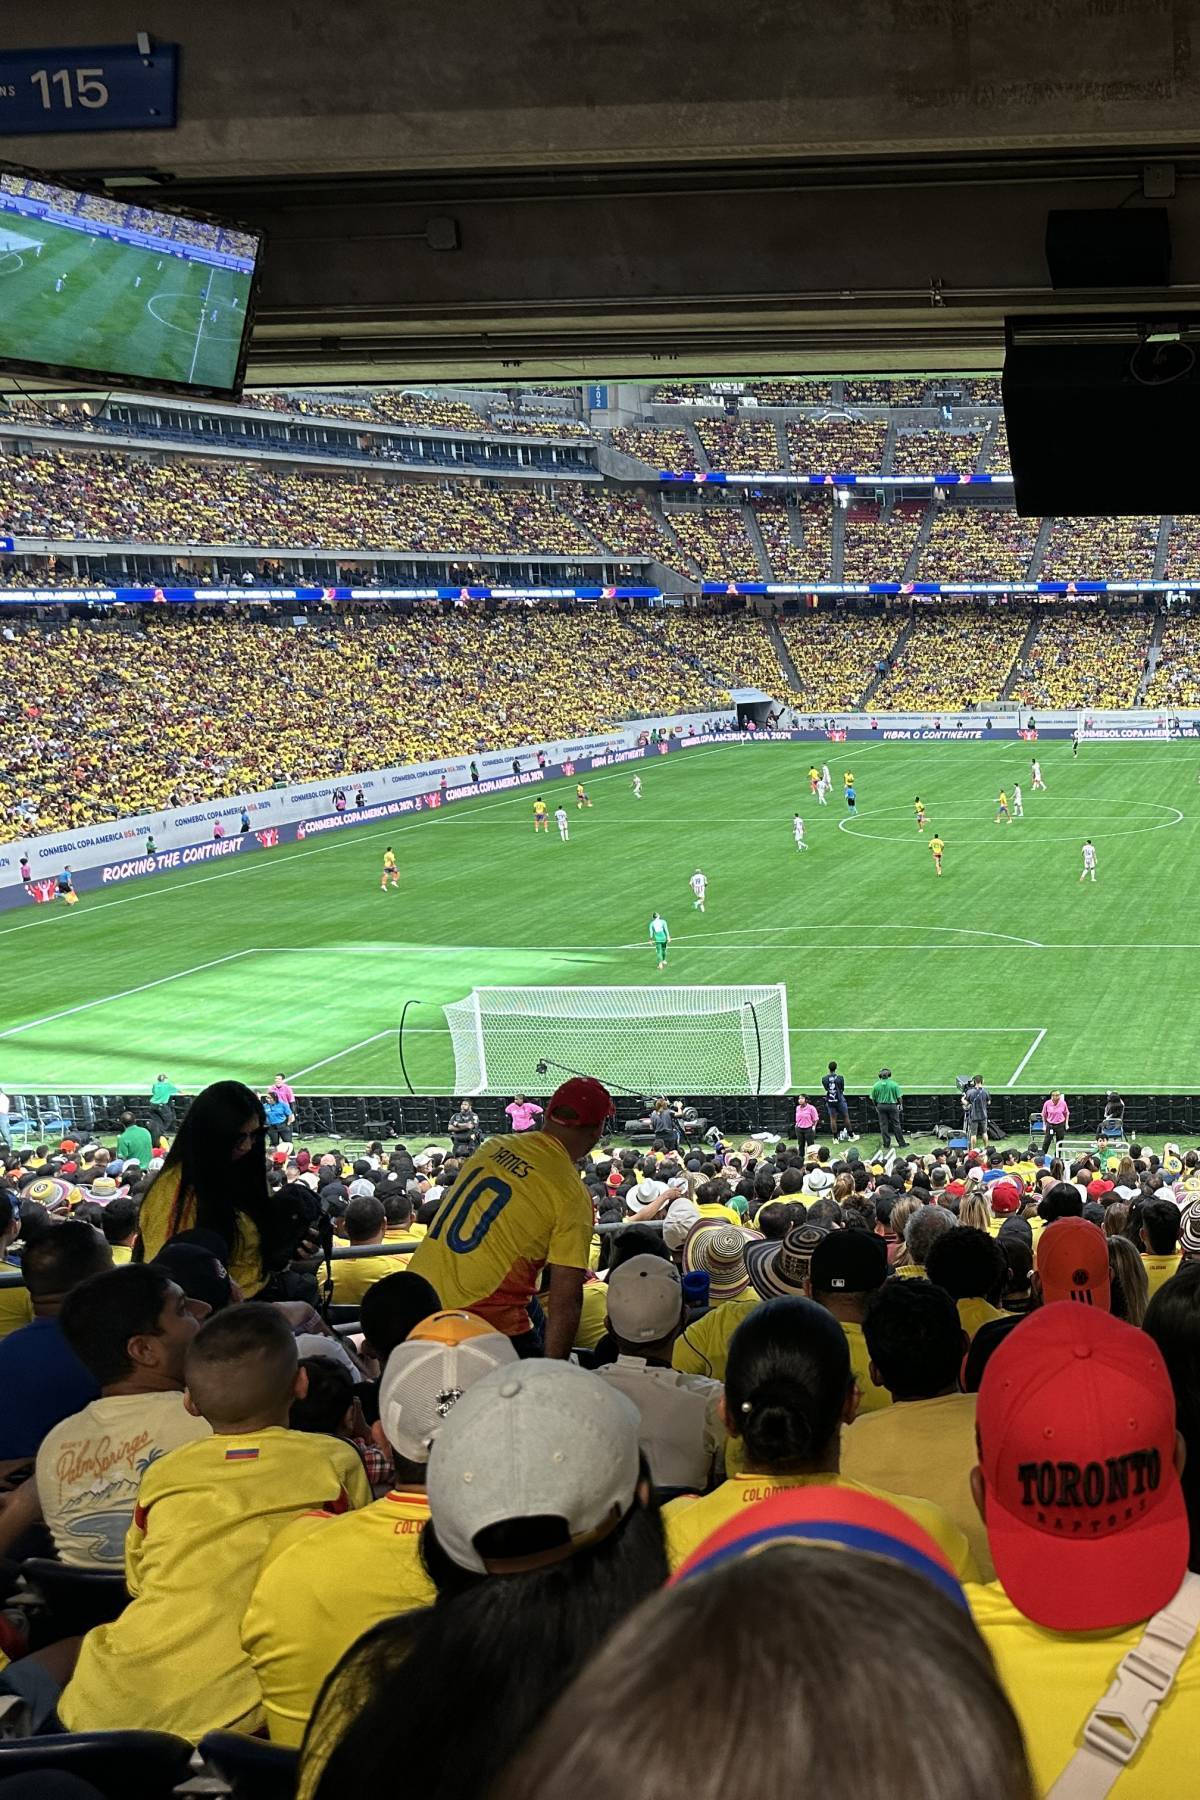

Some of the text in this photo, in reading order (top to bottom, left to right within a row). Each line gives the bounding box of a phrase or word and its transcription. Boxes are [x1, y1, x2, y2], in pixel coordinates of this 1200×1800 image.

[30, 68, 109, 109] 115
[753, 731, 770, 740] USA
[883, 730, 984, 740] VIBRA O CONTINENTE
[174, 813, 208, 828] CONMEBOL
[207, 811, 223, 821] COPA
[39, 825, 151, 858] CONMEBOL COPA AMERICA USA 2024
[102, 836, 245, 883] ROCKING THE CONTINENT
[488, 1146, 535, 1179] JAMES
[428, 1166, 513, 1255] 10
[56, 1430, 154, 1486] Palm Springs
[1017, 1447, 1161, 1508] TORONTO
